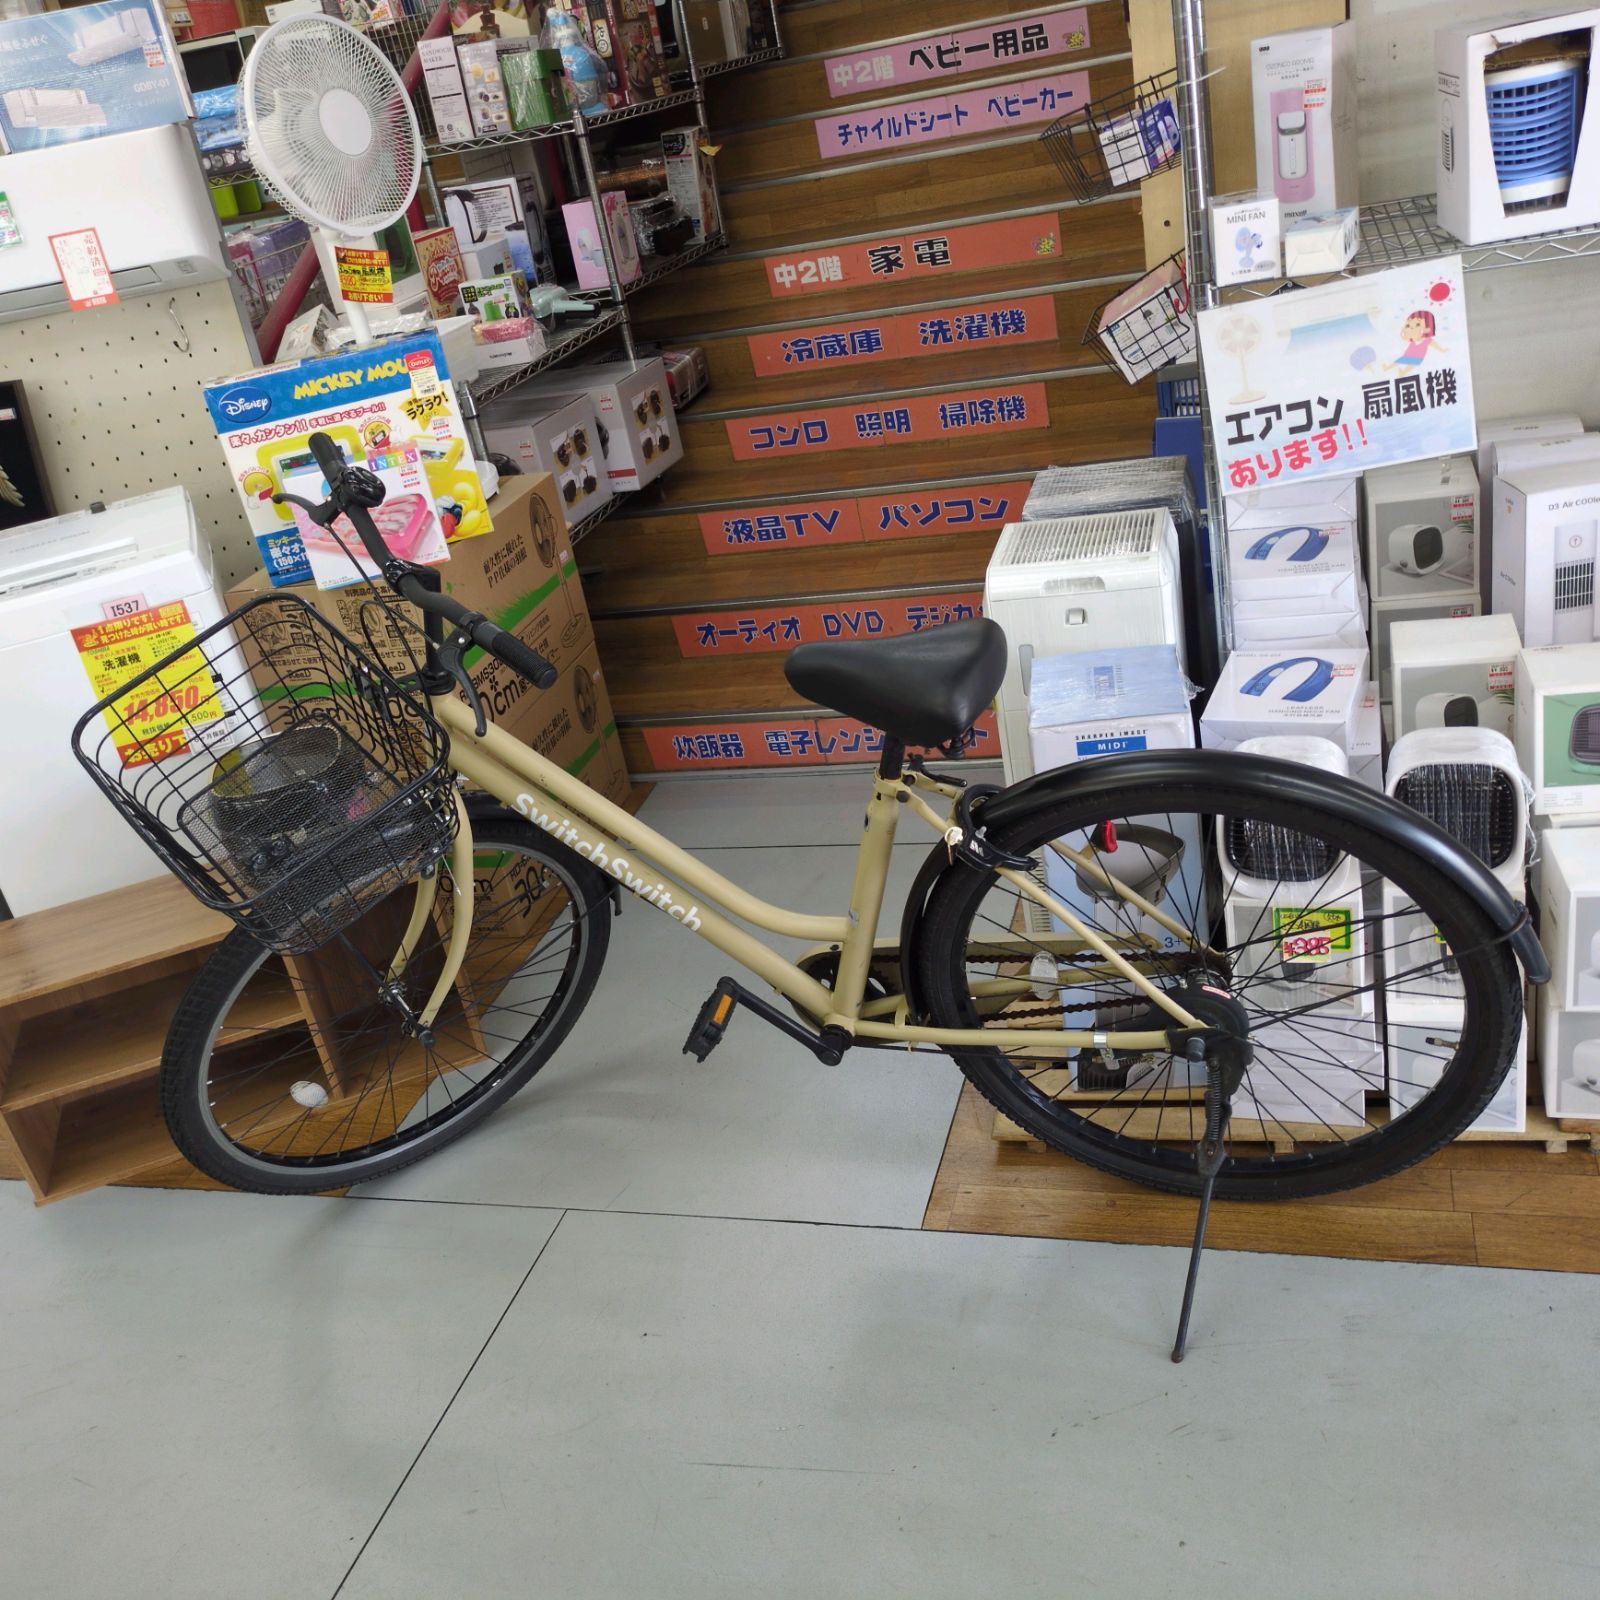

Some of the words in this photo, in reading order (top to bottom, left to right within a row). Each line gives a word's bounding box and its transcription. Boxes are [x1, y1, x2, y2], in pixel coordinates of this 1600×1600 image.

[832, 55, 895, 88] 中2階
[908, 23, 1050, 70] ベビー用品
[838, 104, 969, 146] チャイルドシート
[987, 87, 1074, 118] ベビーカー
[773, 255, 843, 289] 中2階
[866, 235, 953, 276] 家電
[781, 328, 884, 365] 冷蔵庫
[918, 309, 1027, 346] 洗濯機
[293, 371, 363, 401] MICKEY
[1225, 395, 1344, 446] エアコン
[1361, 368, 1458, 421] 扇風機
[749, 420, 829, 451] コンロ
[855, 408, 911, 439] 照明
[939, 395, 1027, 430] 掃除機
[368, 452, 417, 471] INTEX
[1227, 418, 1370, 490] あります!!
[723, 509, 840, 544] 液晶TV
[879, 497, 1010, 531] パソコン
[696, 616, 801, 647] オーディオ
[822, 610, 884, 637] DVD
[906, 604, 984, 633] デジカ
[102, 652, 142, 672] 洗濯機
[672, 731, 744, 760] 炊飯器
[763, 727, 884, 757] 電子レンジ
[1097, 742, 1127, 751] MIDI
